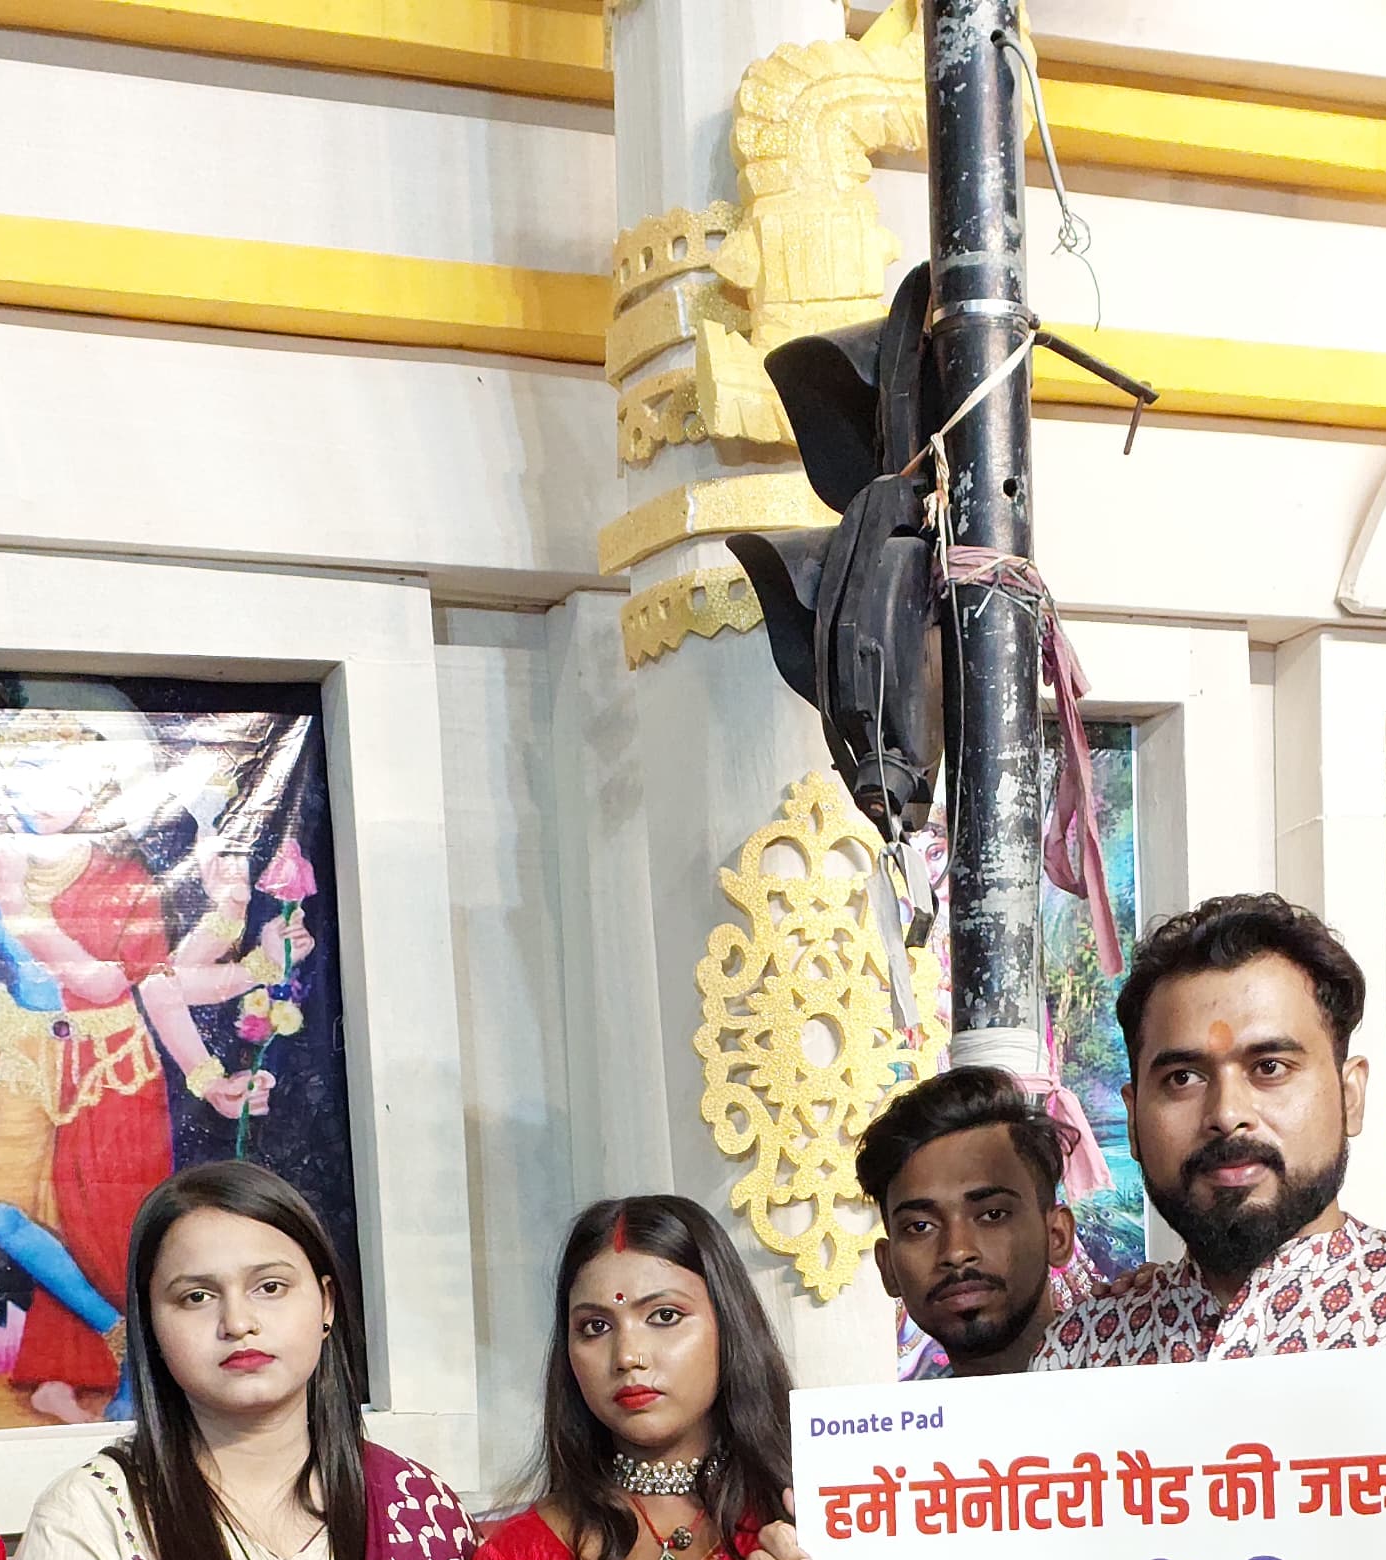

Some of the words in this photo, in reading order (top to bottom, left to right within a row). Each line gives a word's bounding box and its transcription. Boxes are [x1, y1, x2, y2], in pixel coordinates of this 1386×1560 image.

[810, 1413, 893, 1438] Donate
[900, 1405, 945, 1431] Pad
[819, 1465, 907, 1540] हमें
[909, 1451, 1109, 1535] सेनेटिरी
[1116, 1449, 1194, 1525] पैड
[1202, 1442, 1281, 1521] की
